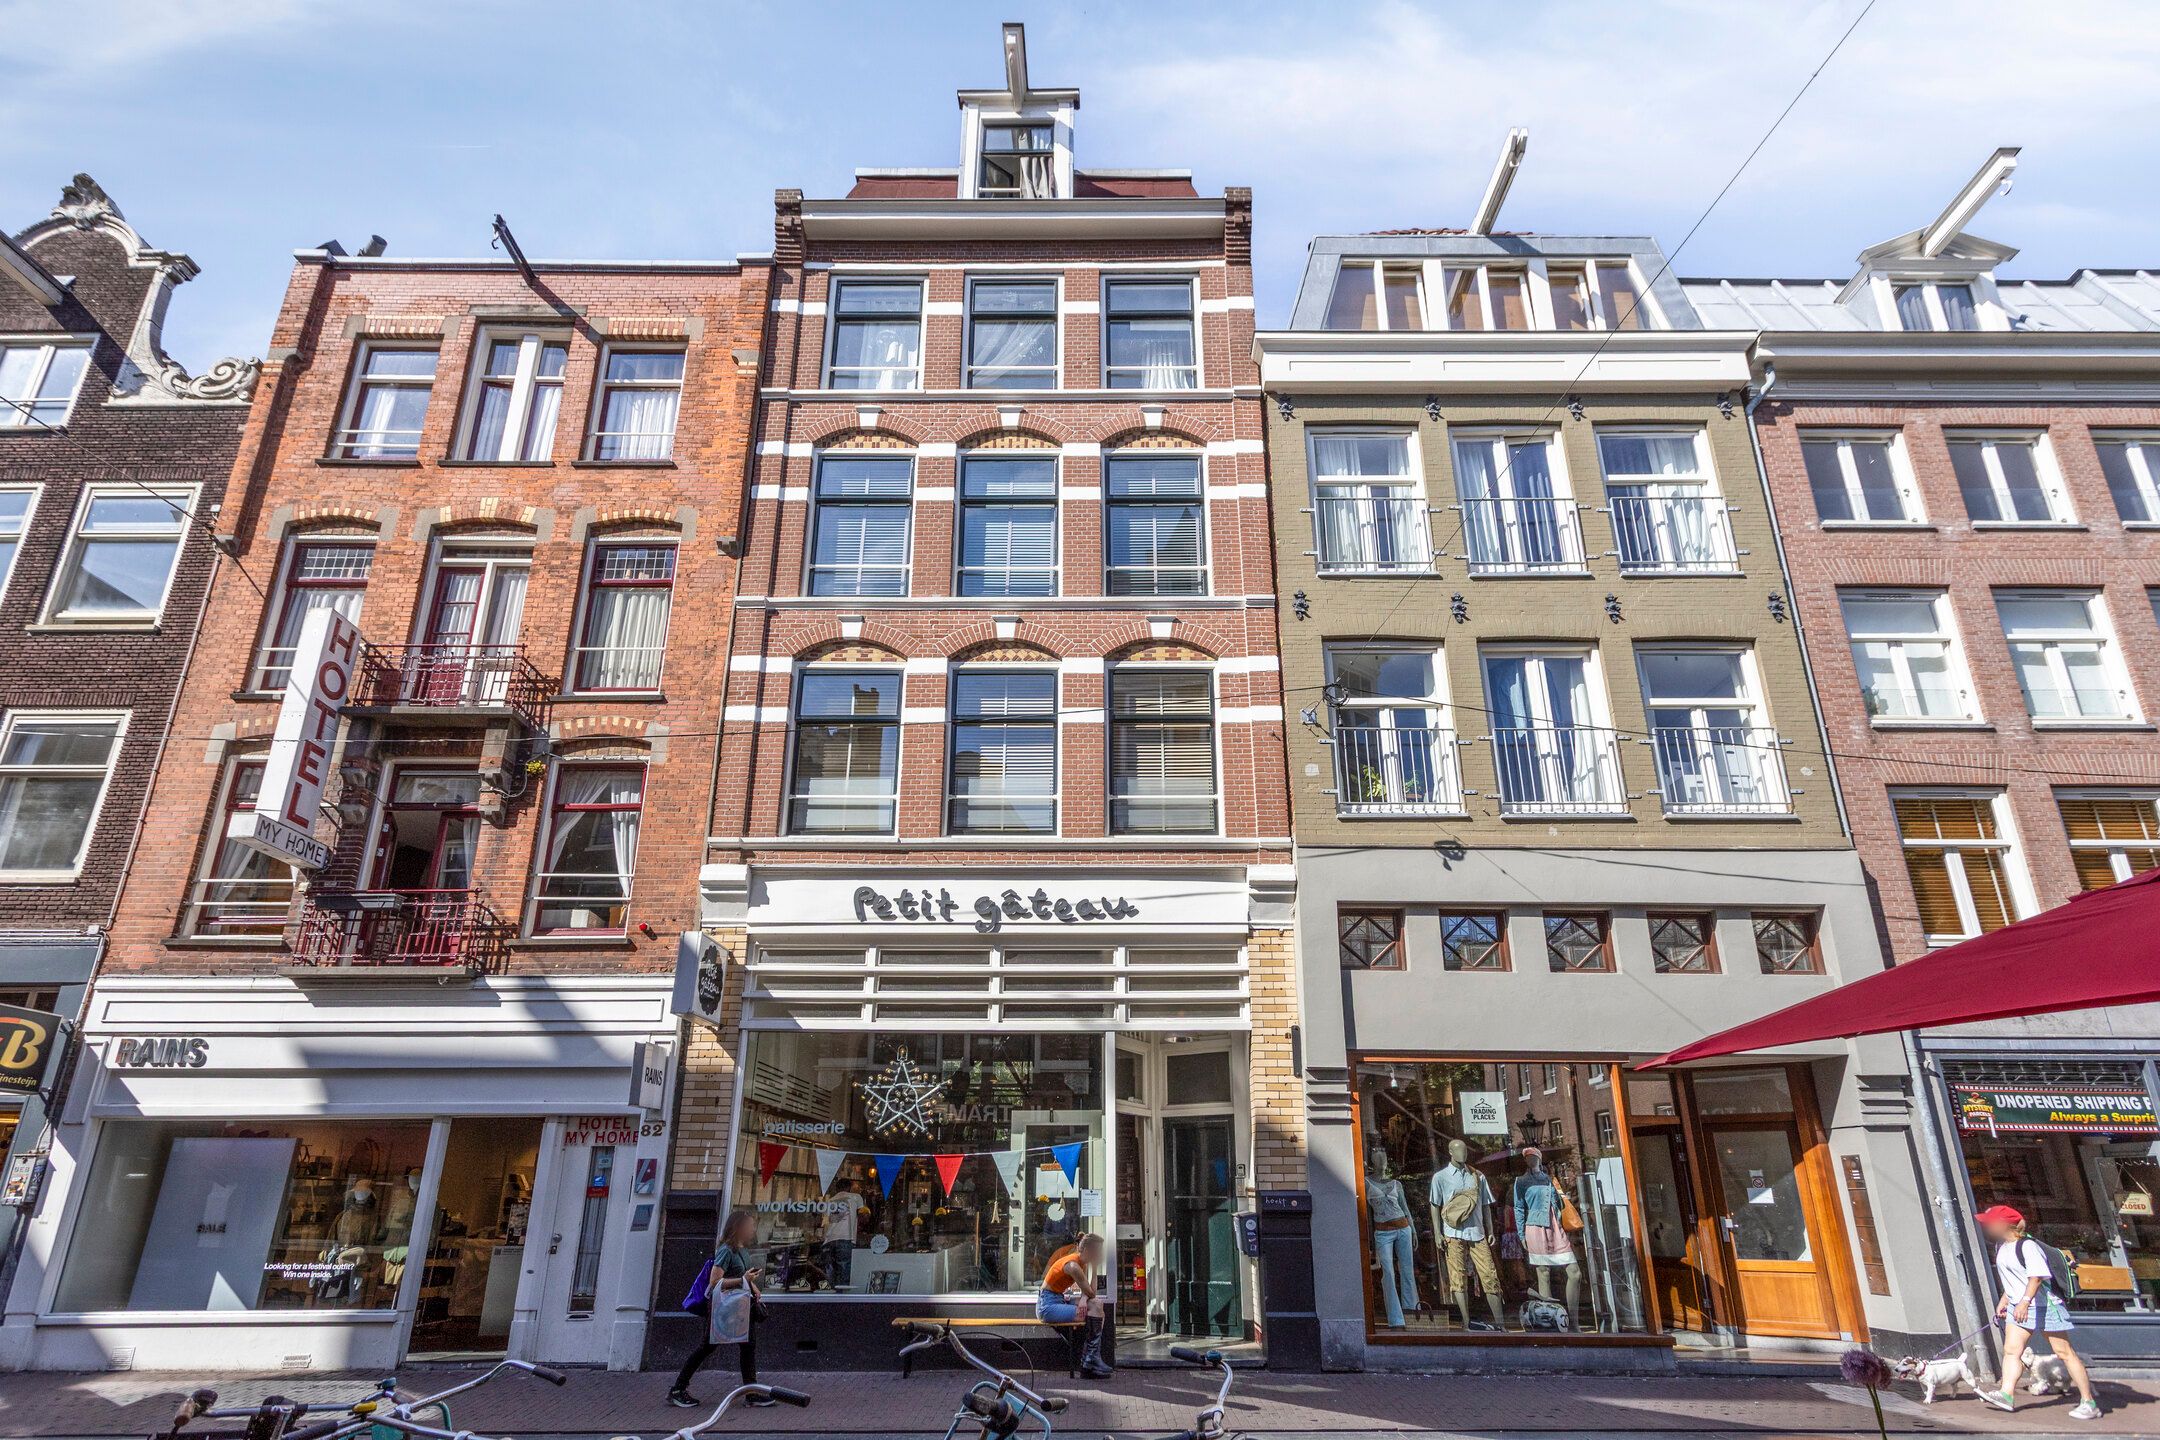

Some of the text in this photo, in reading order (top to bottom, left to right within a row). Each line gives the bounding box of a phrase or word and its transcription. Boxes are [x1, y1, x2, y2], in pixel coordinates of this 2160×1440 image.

[286, 617, 358, 829] HOTEL
[258, 819, 325, 864] MY HOME
[853, 886, 1140, 933] Petit gâteau
[115, 1038, 209, 1067] RAINS
[644, 1067, 662, 1086] RAINS
[1962, 1104, 1994, 1113] MYSTERY
[1994, 1094, 2073, 1109] UNOPENED
[2074, 1095, 2142, 1110] SHIPPING
[578, 1116, 631, 1130] HOTEL
[2050, 1111, 2098, 1124] Always
[2100, 1114, 2109, 1122] a
[764, 1119, 846, 1137] patisserie
[564, 1131, 590, 1144] MY
[755, 1199, 850, 1215] workshops
[264, 1262, 292, 1271] Looking
[292, 1262, 303, 1270] for
[308, 1262, 332, 1270] festival
[332, 1262, 355, 1271] outfit?
[283, 1270, 297, 1278] Win
